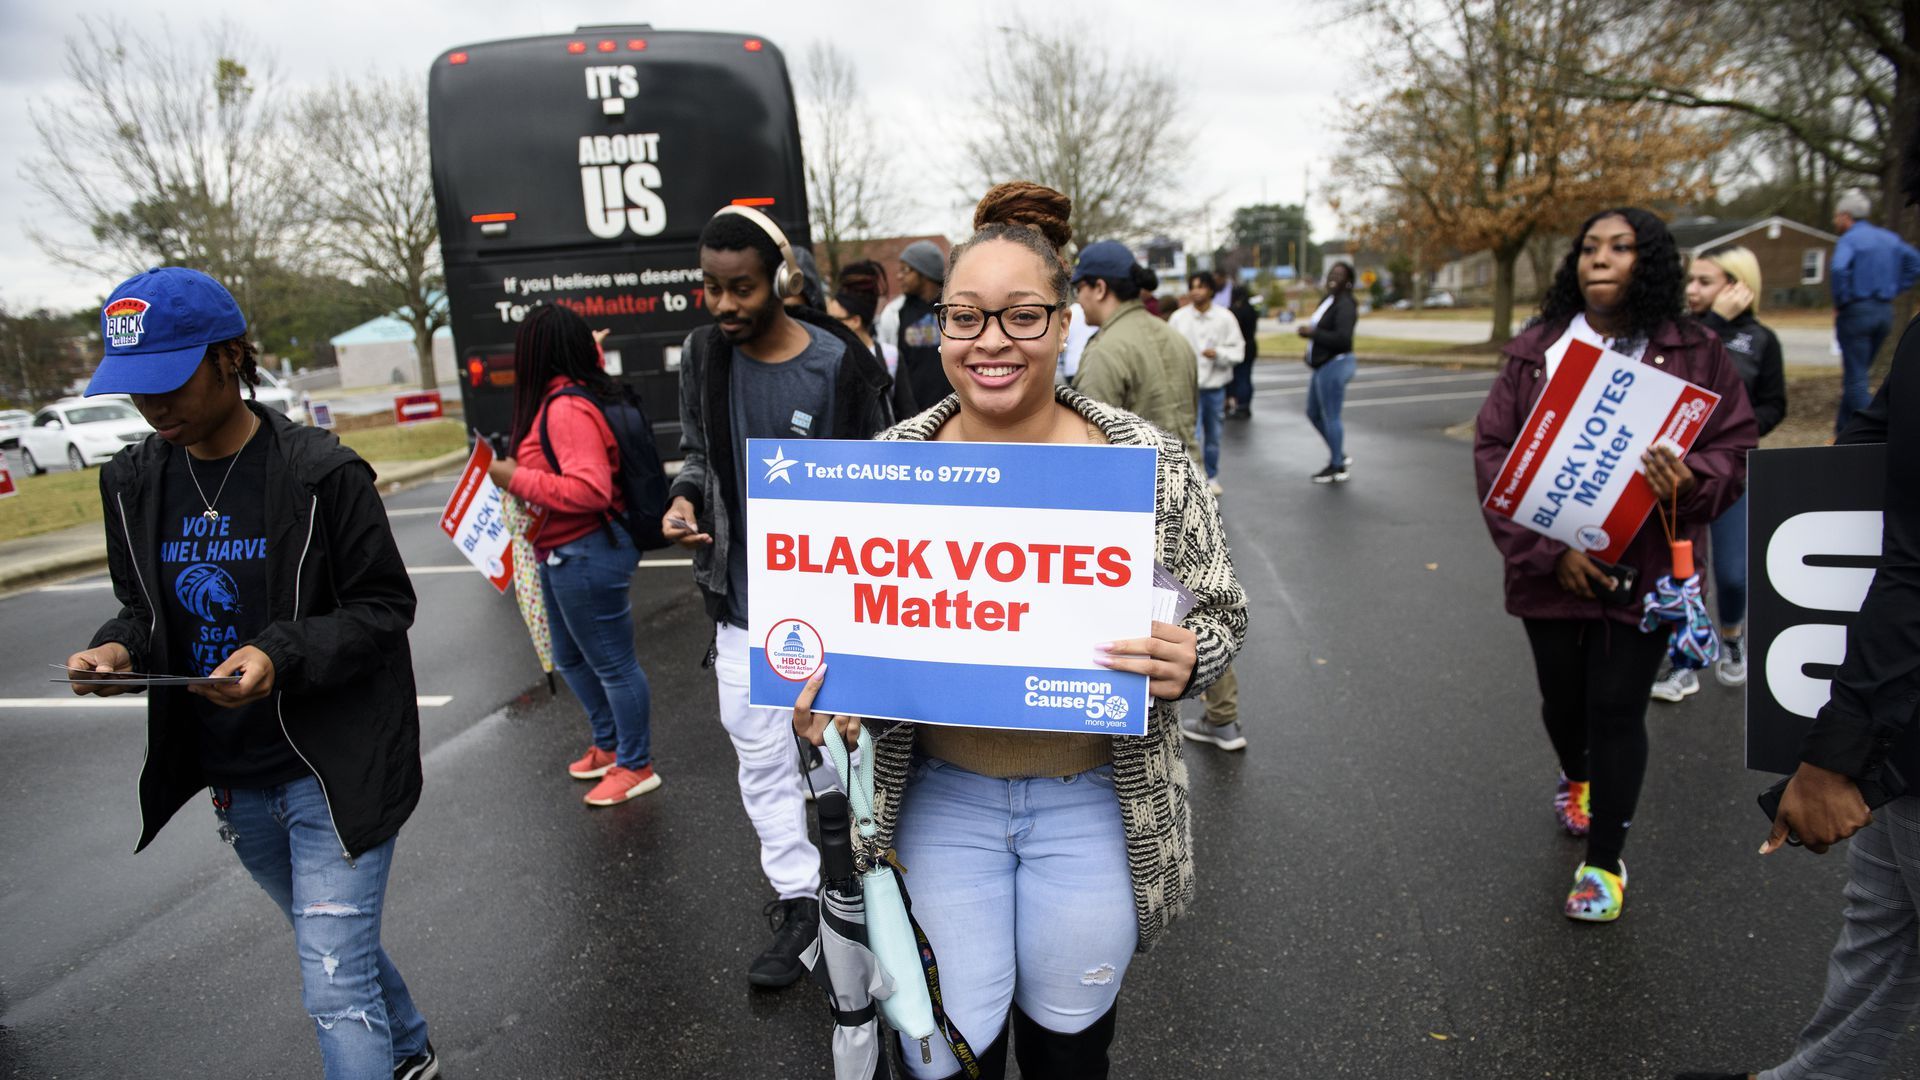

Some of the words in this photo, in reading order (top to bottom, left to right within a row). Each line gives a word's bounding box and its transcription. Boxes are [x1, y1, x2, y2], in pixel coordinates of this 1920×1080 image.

[585, 65, 639, 99] IT'S
[579, 133, 660, 165] ABOUT
[580, 162, 667, 239] US
[504, 277, 517, 294] If
[520, 278, 550, 296] you
[552, 272, 612, 290] believe
[614, 272, 638, 286] we
[663, 291, 688, 312] to
[108, 316, 142, 336] BLACK
[1532, 456, 1587, 528] BLACK
[1574, 368, 1636, 453] VOTES
[805, 462, 843, 480] Text
[847, 463, 911, 482] CAUSE
[915, 465, 934, 482] to
[937, 465, 1001, 484] 97779
[1573, 424, 1635, 508] Matter
[182, 515, 231, 538] VOTE
[463, 502, 495, 553] BLACK
[160, 541, 201, 563] ANEL
[205, 537, 267, 562] HARVE
[766, 533, 932, 579] BLACK
[945, 541, 1132, 588] VOTES
[854, 582, 1030, 632] Matter
[200, 625, 238, 642] SGA
[192, 641, 239, 665] VIC
[781, 657, 807, 666] HBCU
[1025, 676, 1112, 694] Common
[1024, 692, 1085, 709] Cause
[1106, 720, 1127, 728] years
